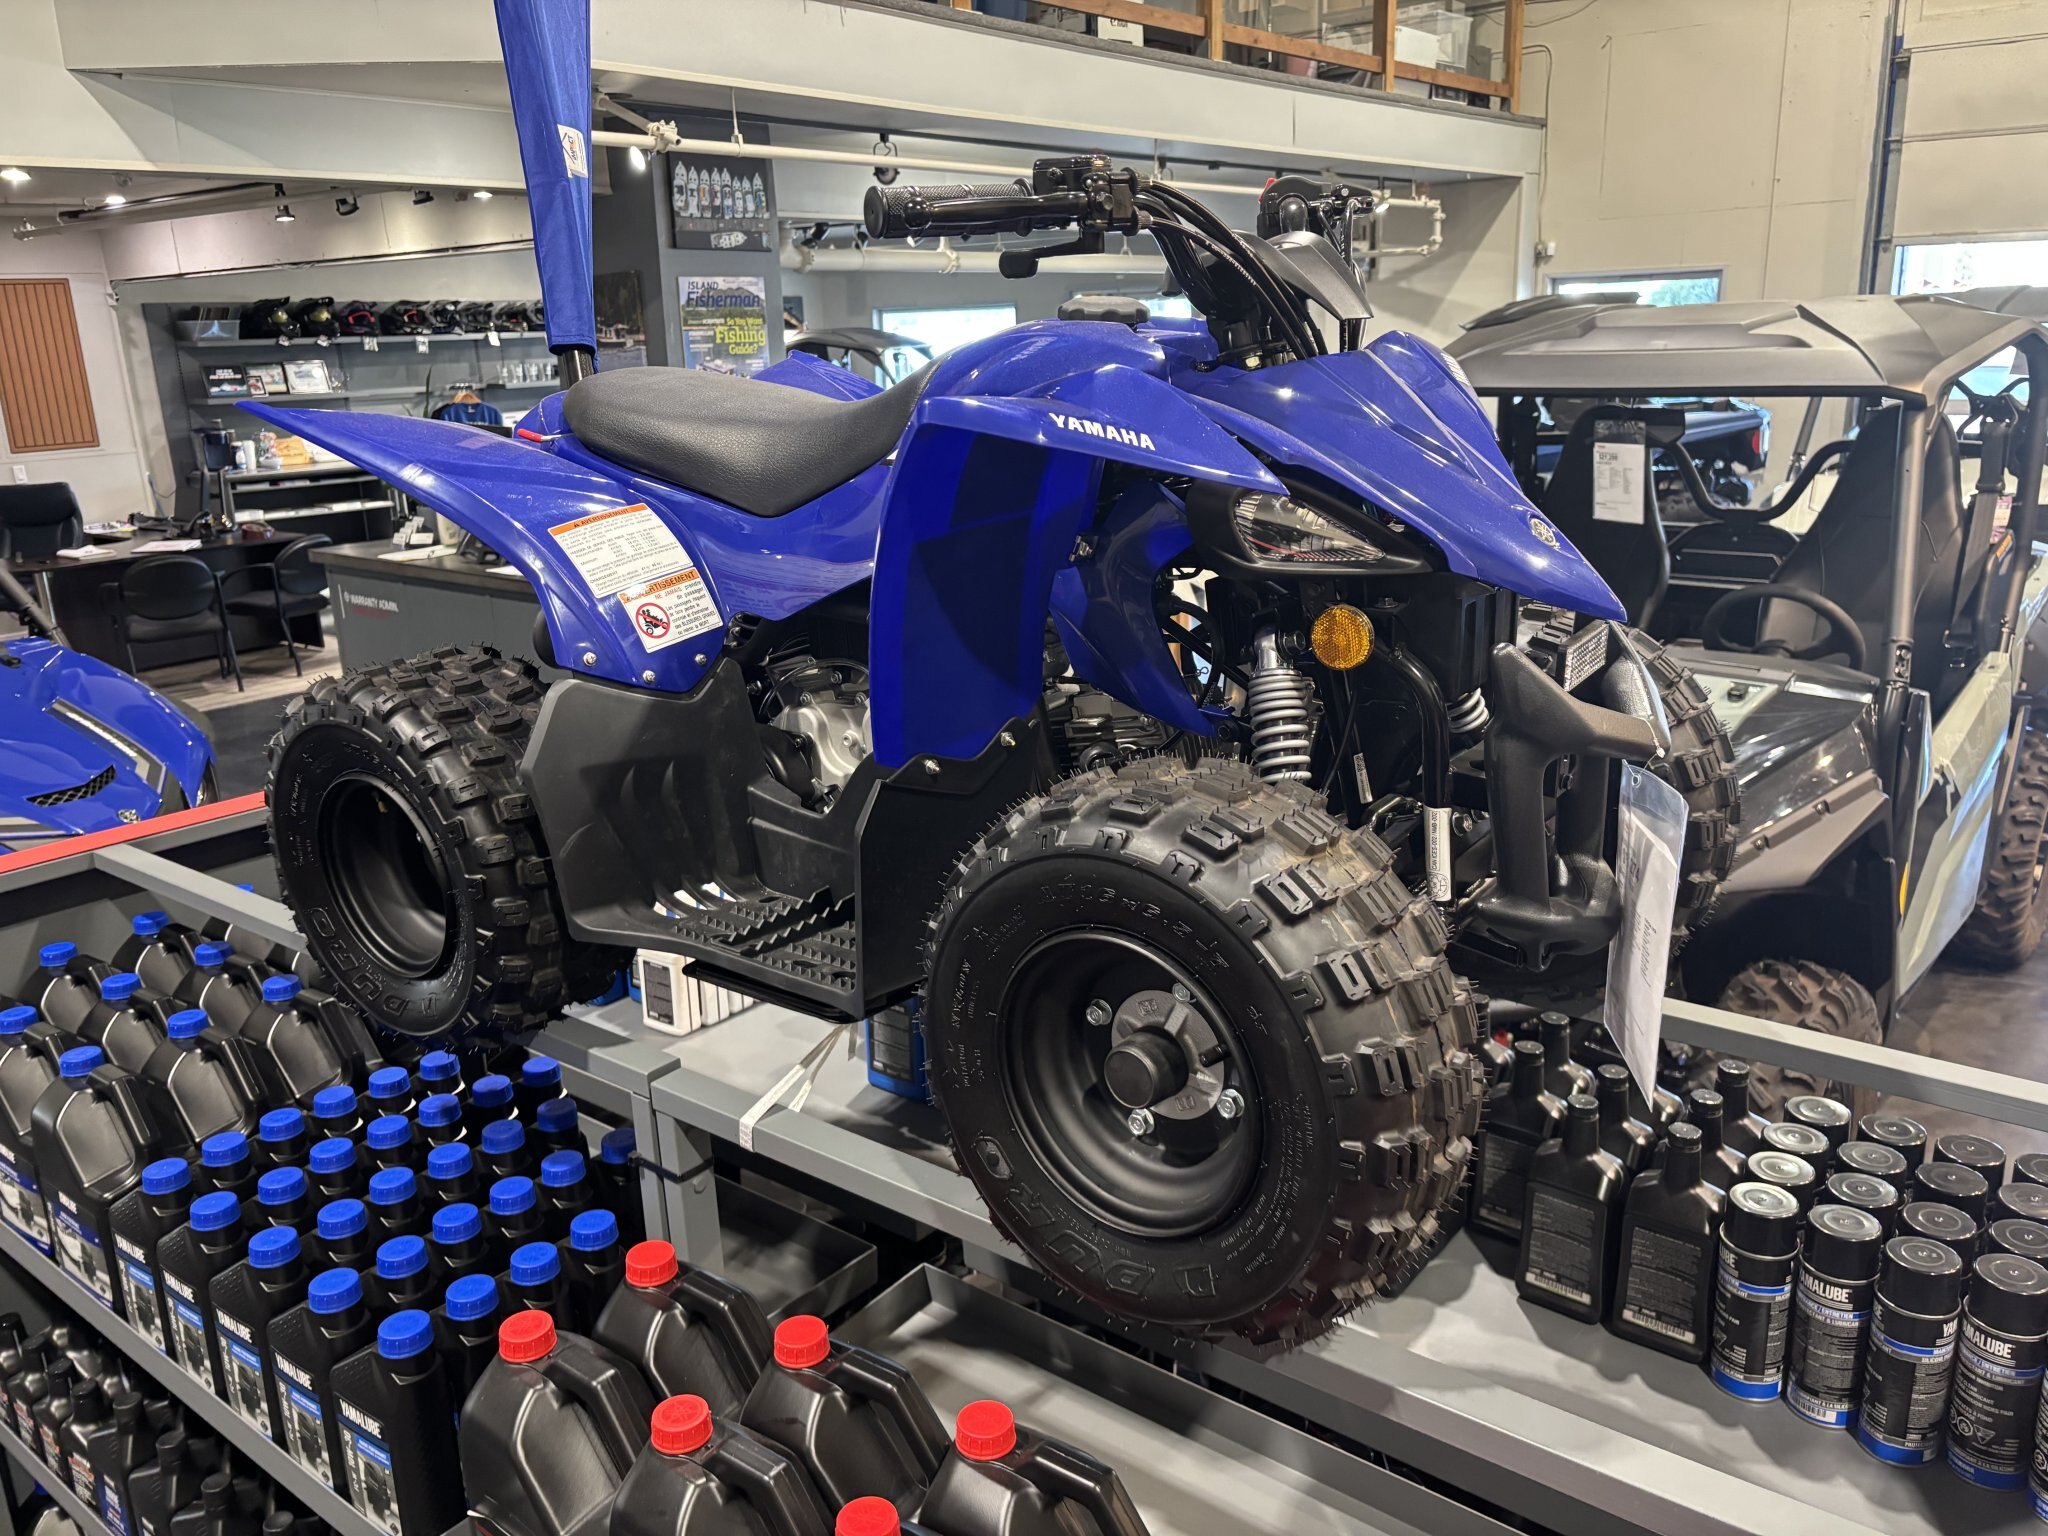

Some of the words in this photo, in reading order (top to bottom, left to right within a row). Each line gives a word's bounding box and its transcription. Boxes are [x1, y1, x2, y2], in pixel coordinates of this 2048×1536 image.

[687, 291, 760, 308] Fisherman
[688, 281, 719, 290] ISLAND
[715, 326, 766, 346] Fishing
[729, 344, 758, 354] Guide?
[1048, 412, 1156, 451] YAMAHA
[580, 507, 629, 526] AVERTISSEMENT
[643, 570, 696, 594] RTISSEMENT
[115, 1233, 146, 1264] YAMALUBE
[1719, 1245, 1737, 1268] LUBE
[163, 1269, 195, 1304] YAMALUBE
[1800, 1270, 1849, 1302] AMALUBE
[216, 1308, 252, 1343] YAMALUBE
[1963, 1319, 2013, 1358] AMALUBE
[275, 1351, 313, 1390] YAMALUBE
[339, 1398, 382, 1440] YAMALUBE
[344, 1430, 356, 1472] 10W-30
